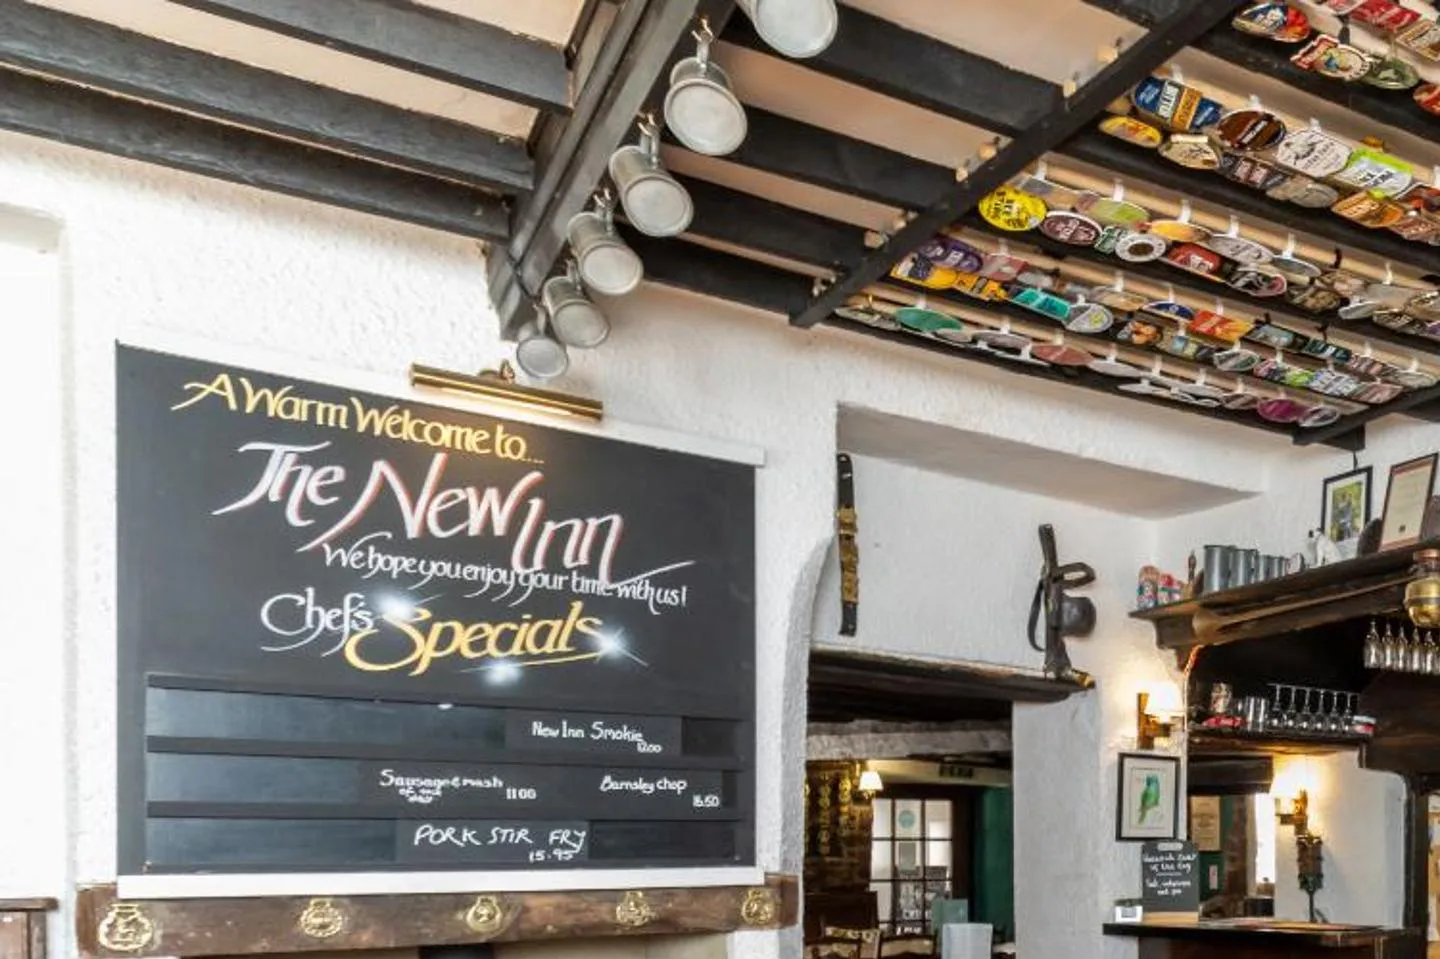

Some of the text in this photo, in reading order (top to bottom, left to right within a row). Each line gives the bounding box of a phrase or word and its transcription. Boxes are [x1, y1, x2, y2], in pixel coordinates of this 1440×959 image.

[171, 373, 238, 411] A
[239, 377, 349, 429] Warm
[350, 397, 491, 454] Welcome
[212, 440, 696, 591] The New Inn
[322, 531, 392, 569] We
[361, 545, 418, 579] hope
[407, 560, 459, 590] you
[462, 563, 516, 603] enjoy
[507, 568, 568, 608] your
[570, 569, 614, 597] time
[616, 576, 661, 615] with
[343, 600, 605, 677] Specials
[532, 720, 644, 742] New Inn Smokie
[599, 775, 688, 795] Barnsley chop
[413, 824, 588, 853] PORK STIR FRY
